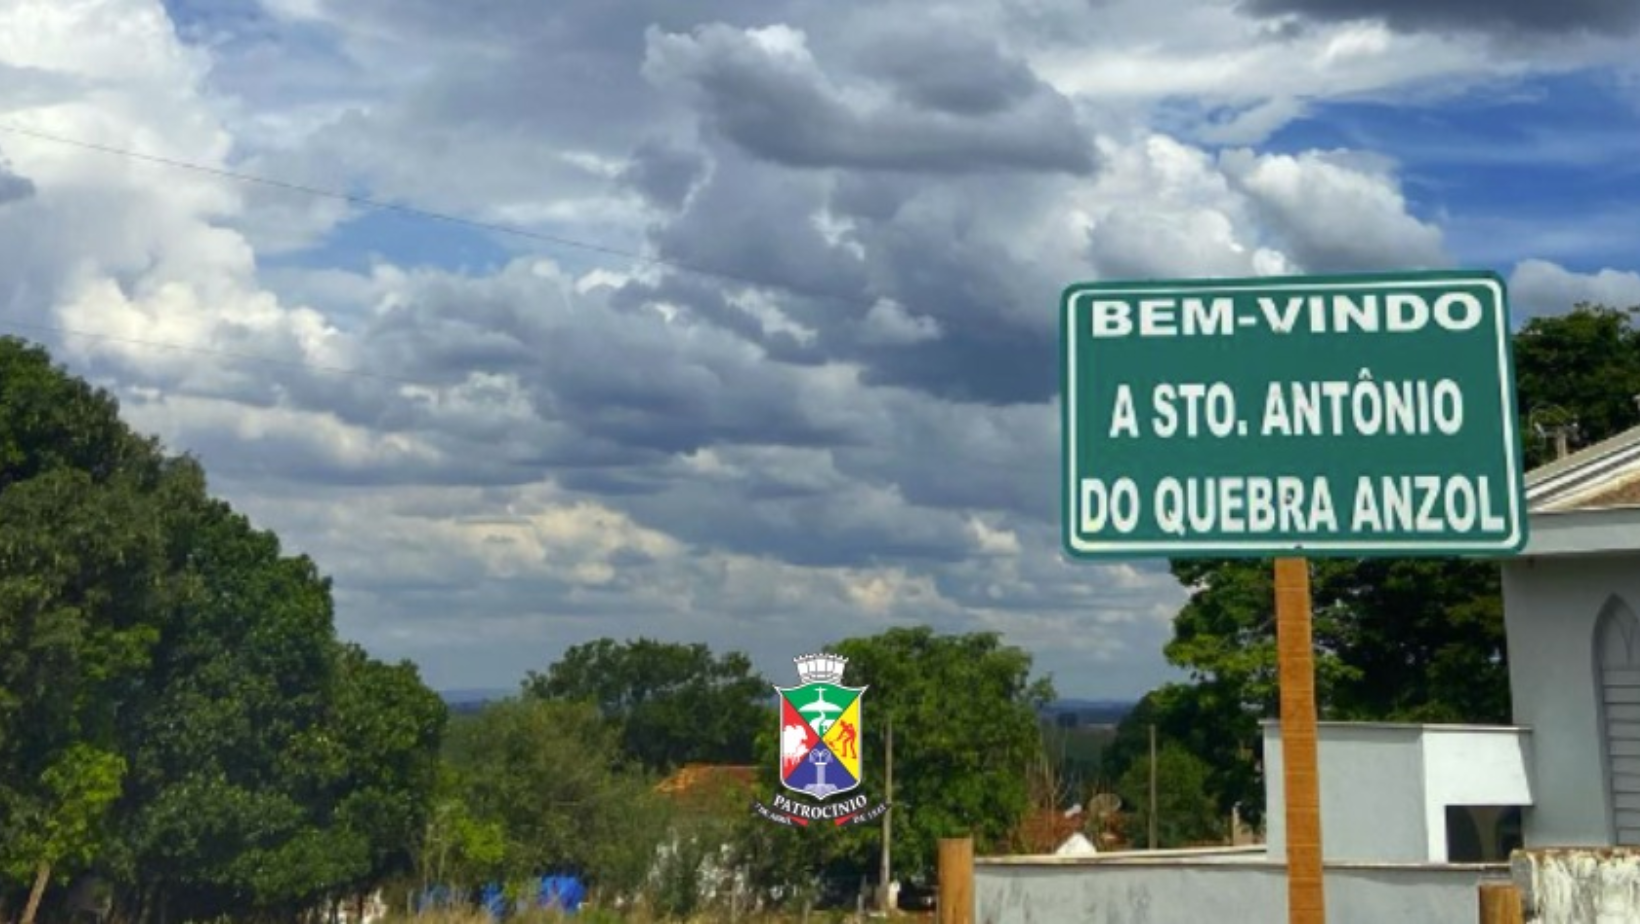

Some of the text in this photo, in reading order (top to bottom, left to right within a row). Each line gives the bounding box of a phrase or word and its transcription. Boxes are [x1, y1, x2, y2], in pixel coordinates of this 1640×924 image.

[1092, 292, 1483, 338] BEM-VINDO
[1109, 367, 1464, 439] A STO. ANTÔNIO
[1080, 474, 1506, 536] DO QUEBRA ANZOL
